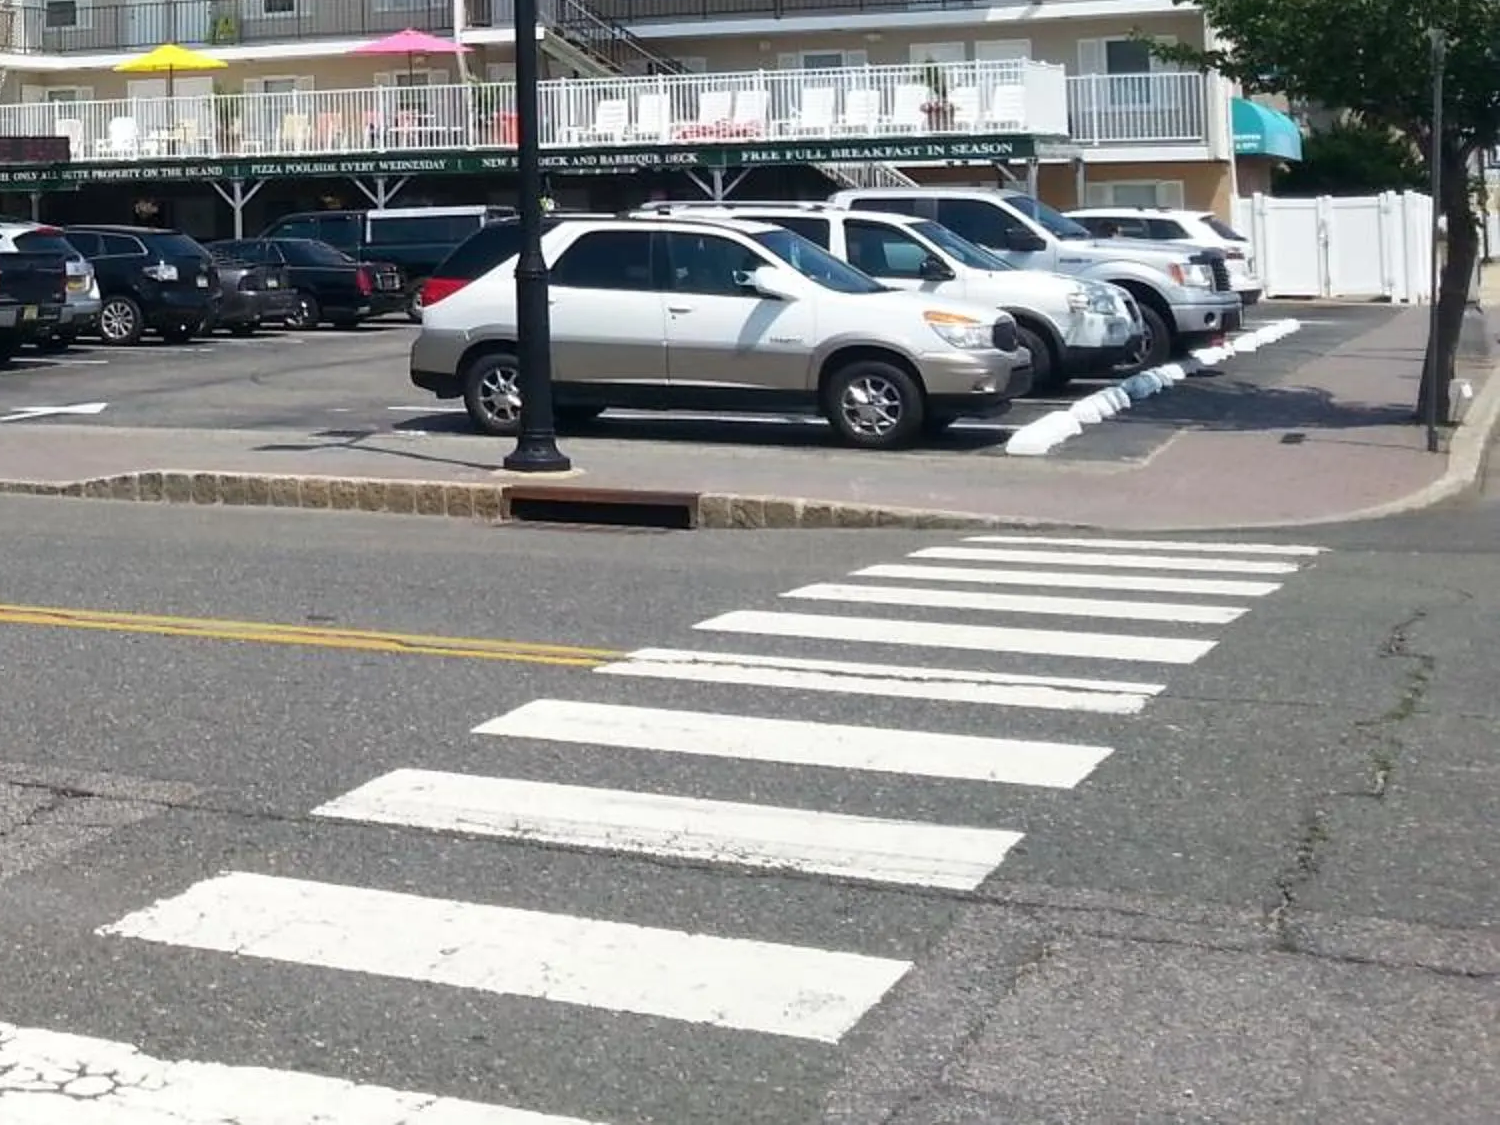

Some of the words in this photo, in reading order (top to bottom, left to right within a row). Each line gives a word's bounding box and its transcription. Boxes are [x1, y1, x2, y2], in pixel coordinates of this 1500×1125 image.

[741, 150, 780, 161] FREE
[785, 149, 827, 160] FULL
[831, 146, 921, 158] BREAKFAST
[927, 145, 945, 156] IN
[950, 142, 1013, 154] SEASON
[251, 164, 282, 174] PIZZA
[285, 163, 338, 173] POOLSIDE
[340, 161, 376, 172] EVERY
[379, 159, 446, 171] WEDNESDAY
[482, 158, 508, 168] NEW
[537, 156, 568, 166] DECK
[571, 155, 597, 166] AND
[600, 154, 661, 167] BARBEQUE
[665, 153, 698, 164] DECK
[13, 172, 37, 180] ONLY
[40, 171, 58, 179] ALL
[143, 169, 158, 178] ON
[161, 168, 182, 177] THE
[185, 166, 223, 176] ISLAND
